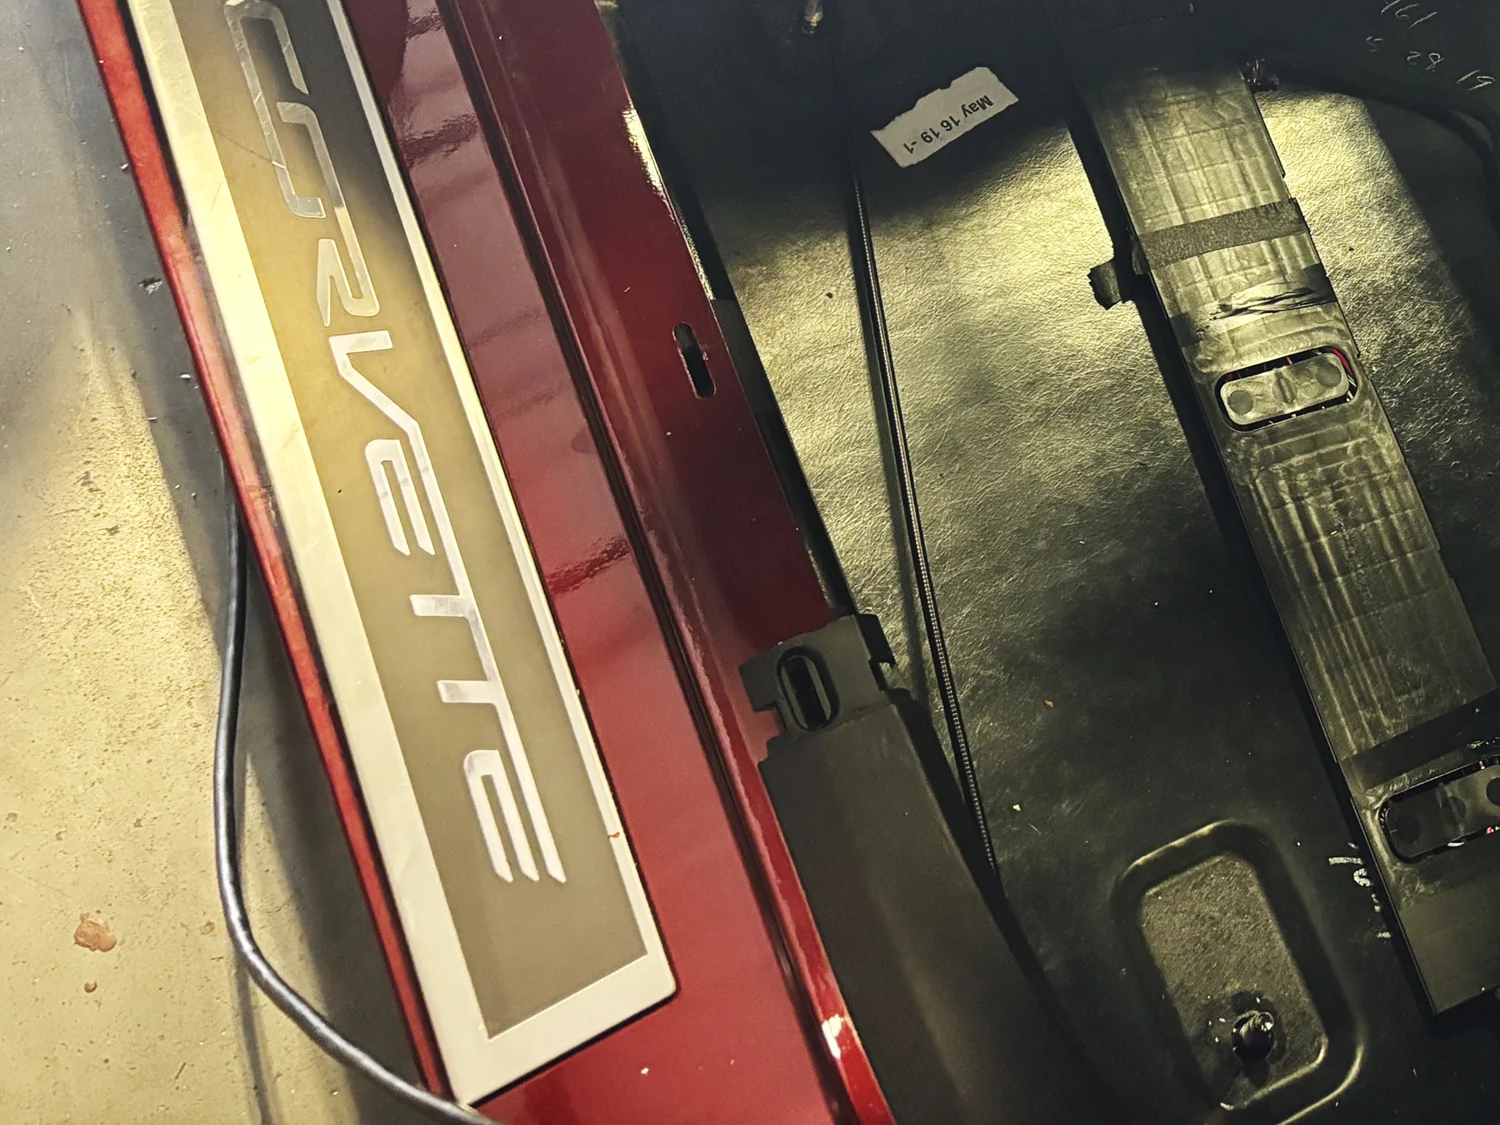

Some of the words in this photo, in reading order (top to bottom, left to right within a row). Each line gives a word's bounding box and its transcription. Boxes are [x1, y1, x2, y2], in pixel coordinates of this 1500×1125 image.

[962, 94, 994, 118] May
[940, 115, 960, 132] 16
[920, 127, 940, 143] 19
[903, 140, 917, 155] -1
